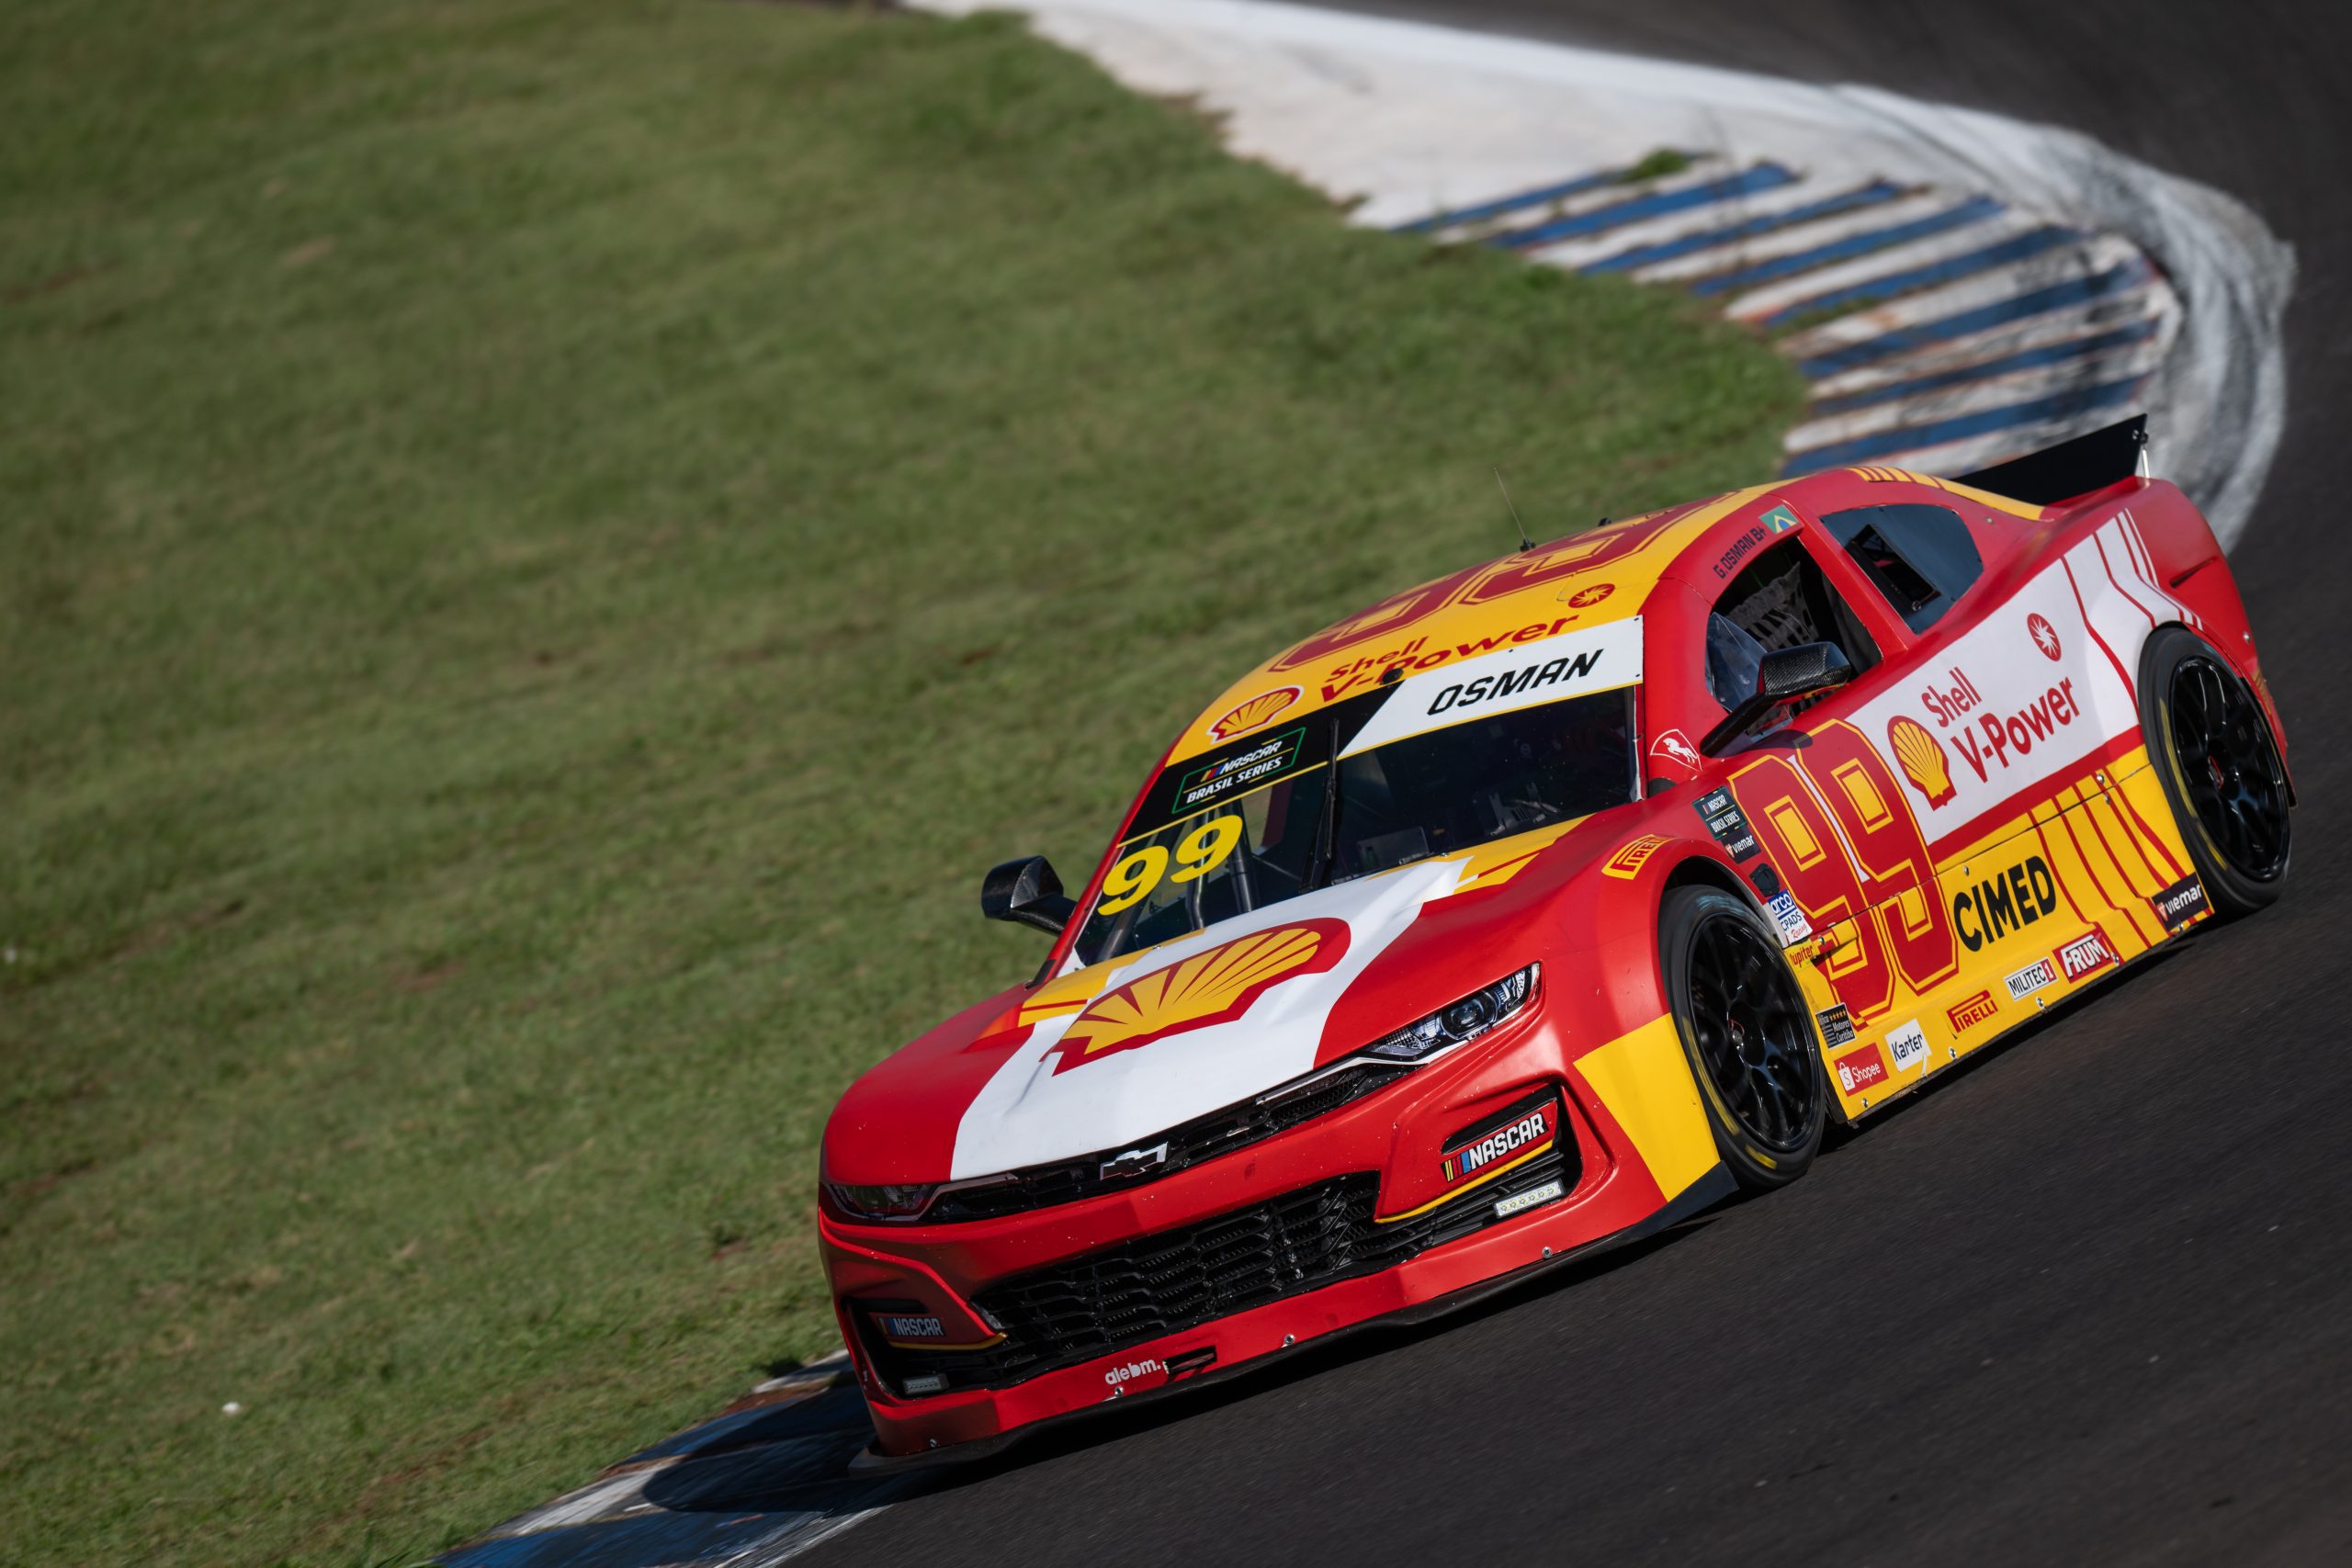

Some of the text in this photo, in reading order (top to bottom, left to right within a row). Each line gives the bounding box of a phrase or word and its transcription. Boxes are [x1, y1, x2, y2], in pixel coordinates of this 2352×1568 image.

[1320, 615, 1580, 703] V-Power
[1324, 636, 1430, 682] Shell
[1427, 649, 1605, 716] OSMAN
[1921, 666, 1983, 728] Shell
[1950, 676, 2080, 784] V-Power
[1186, 756, 1283, 804] BRASIL SERIES
[1219, 740, 1283, 774] NASCAR
[1097, 815, 1243, 916] 99
[1726, 718, 1960, 1032] 99
[1953, 855, 2056, 953] CIMED
[2165, 884, 2202, 915] viemar
[2060, 933, 2110, 978] FRUM
[1946, 989, 1999, 1033] PIRELLI
[1892, 1032, 1923, 1062] Karter
[1851, 1063, 1881, 1083] Shopee
[1468, 1112, 1545, 1170] NASCAR
[893, 1317, 944, 1337] NASCAR
